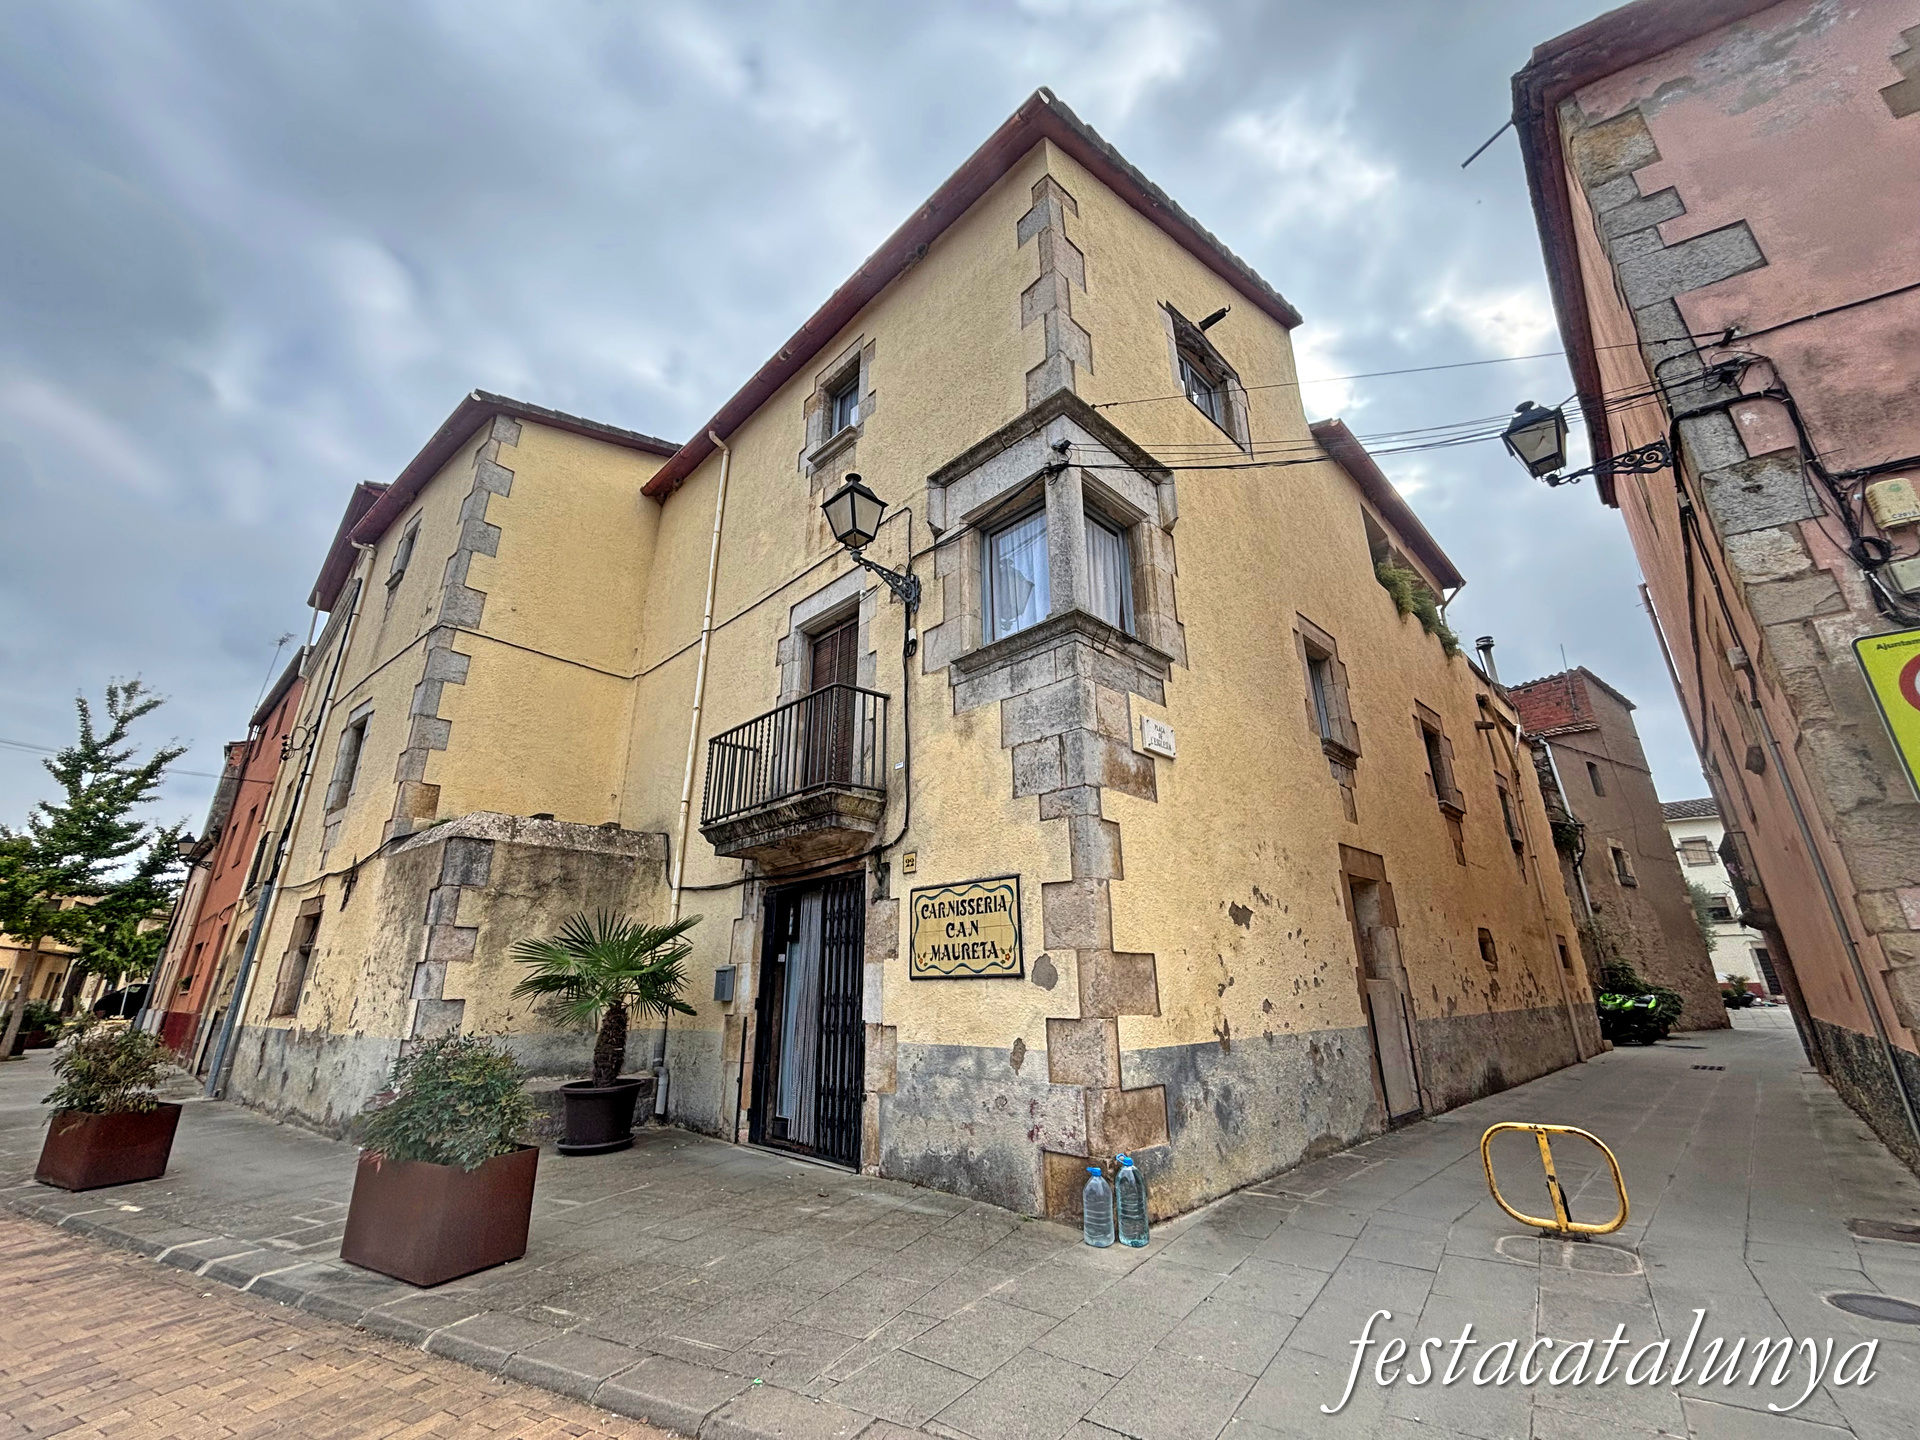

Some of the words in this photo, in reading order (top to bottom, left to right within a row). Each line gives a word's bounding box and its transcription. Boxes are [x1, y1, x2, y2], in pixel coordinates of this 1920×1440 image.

[905, 858, 915, 867] 22
[921, 895, 1007, 919] CARNISSERIA
[946, 920, 979, 938] CAN
[930, 941, 999, 961] MAURETA
